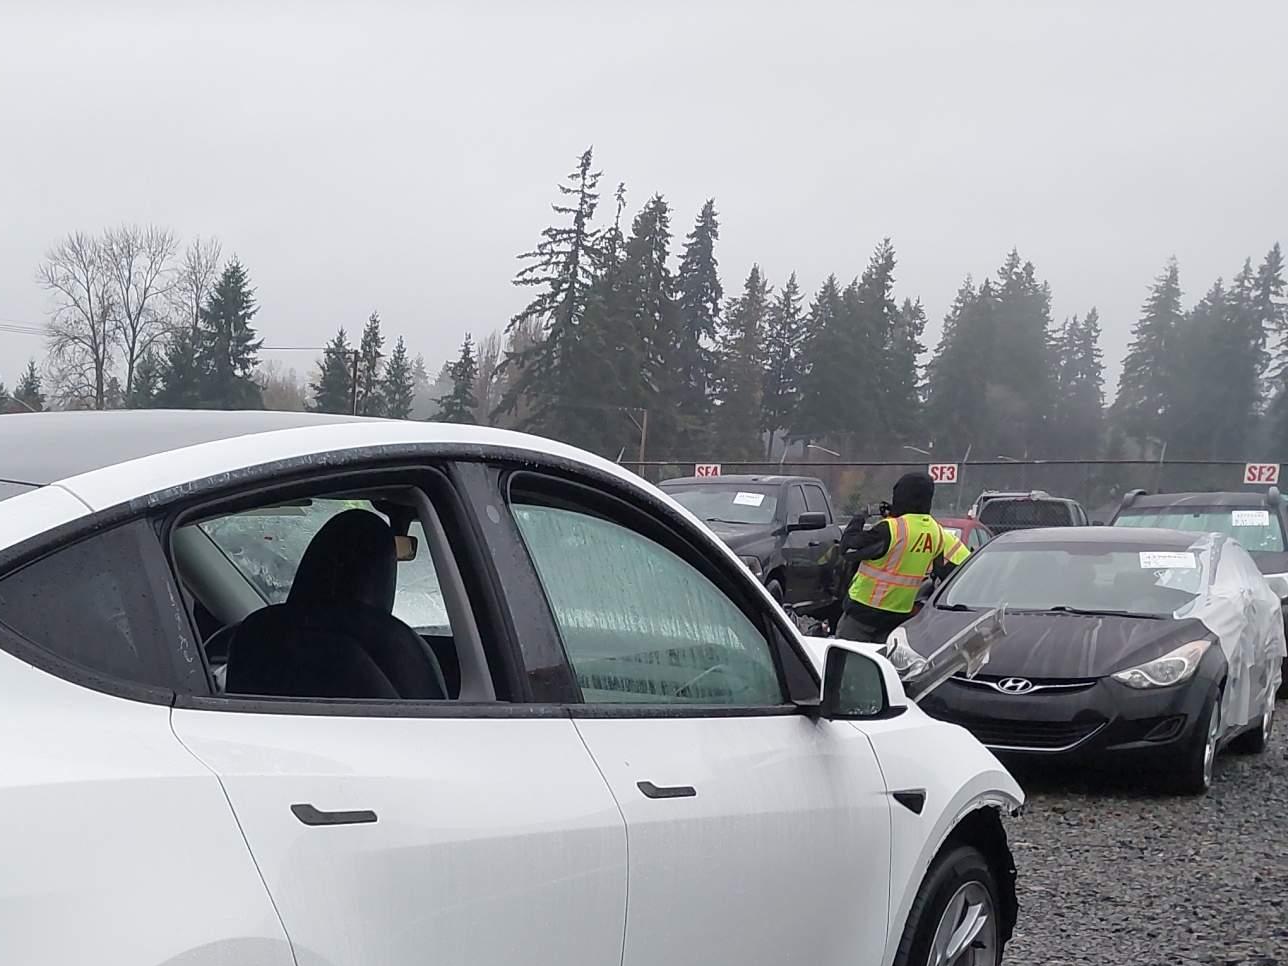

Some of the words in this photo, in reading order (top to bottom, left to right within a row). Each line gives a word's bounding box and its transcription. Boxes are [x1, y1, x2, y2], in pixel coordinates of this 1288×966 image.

[697, 466, 718, 477] SF4
[931, 466, 955, 481] SF3
[1247, 465, 1277, 482] SF2
